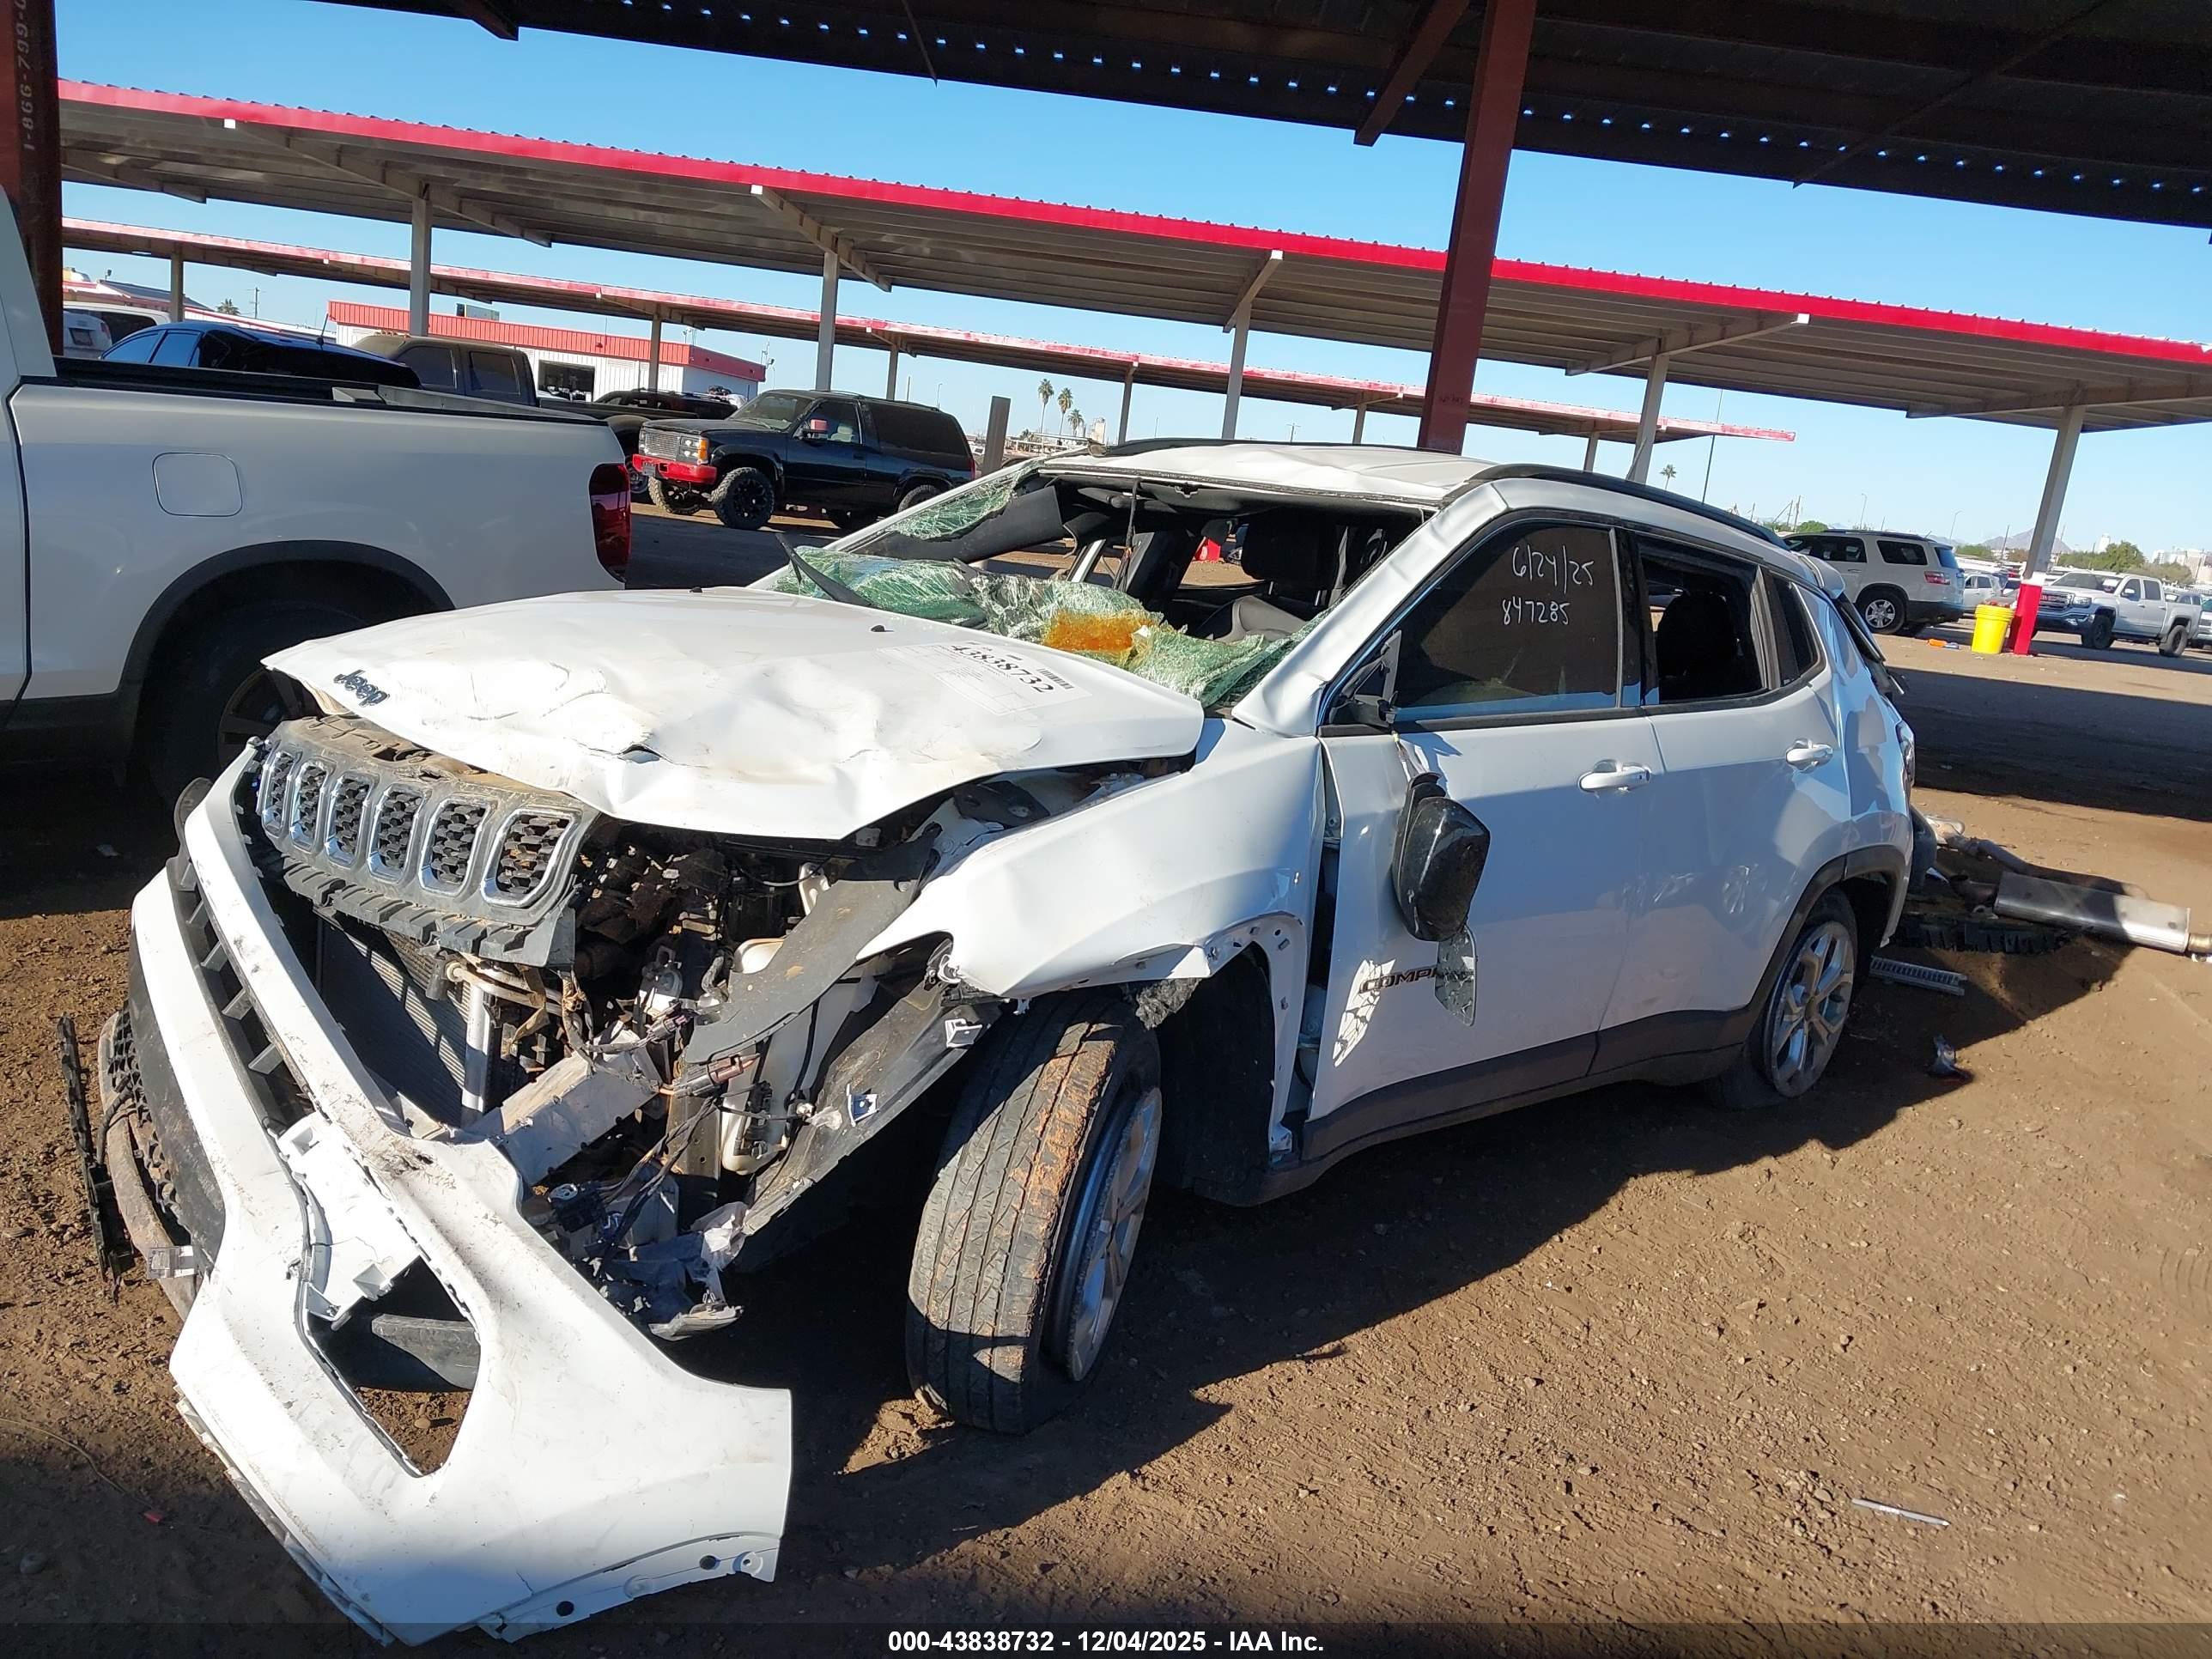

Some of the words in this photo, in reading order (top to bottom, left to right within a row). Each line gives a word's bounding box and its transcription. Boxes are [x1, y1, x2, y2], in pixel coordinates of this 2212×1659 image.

[1512, 544, 1595, 594] 6/24/25
[1502, 596, 1571, 625] 847285
[333, 669, 390, 708] Jeep
[951, 645, 1054, 693] 43838732
